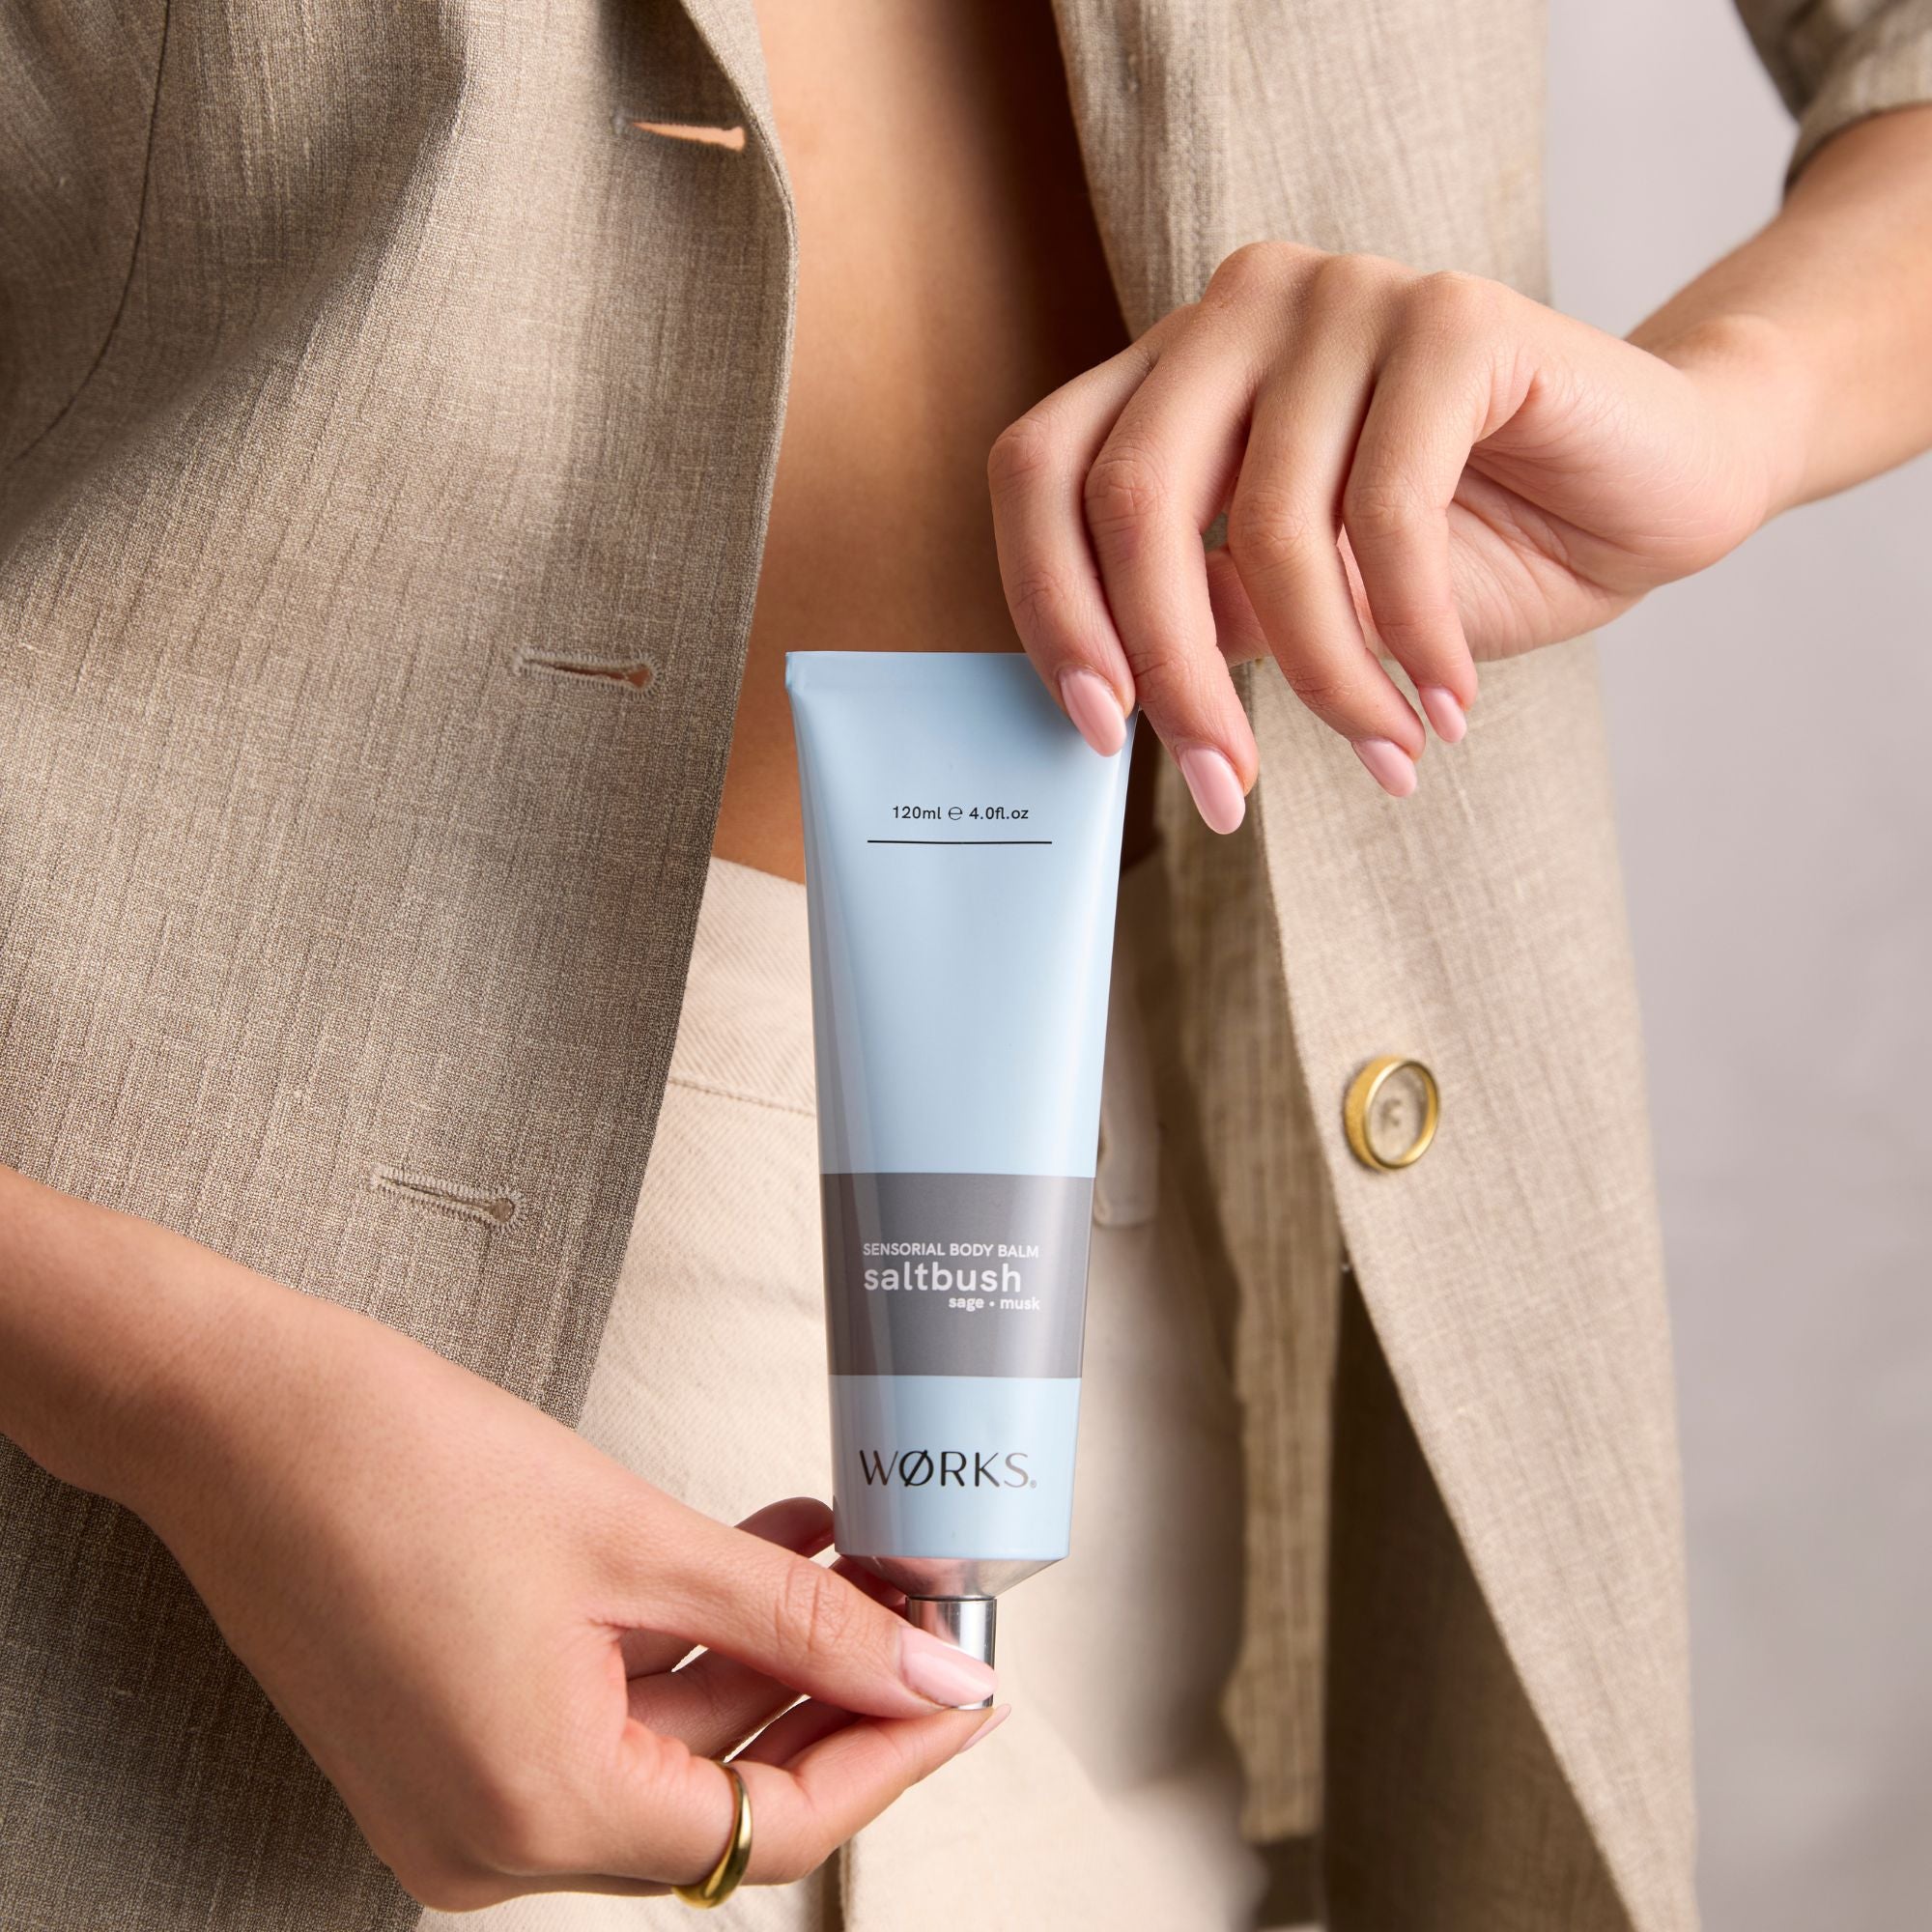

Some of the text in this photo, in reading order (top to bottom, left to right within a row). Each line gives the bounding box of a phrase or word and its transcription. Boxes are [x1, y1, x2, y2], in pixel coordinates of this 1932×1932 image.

[892, 806, 942, 820] 120ml
[968, 806, 1030, 820] 4.0fl.oz
[862, 1242, 1039, 1259] SENSORIAL BODY BALM
[863, 1261, 1022, 1293] saltbush
[948, 1296, 1041, 1313] sage musk
